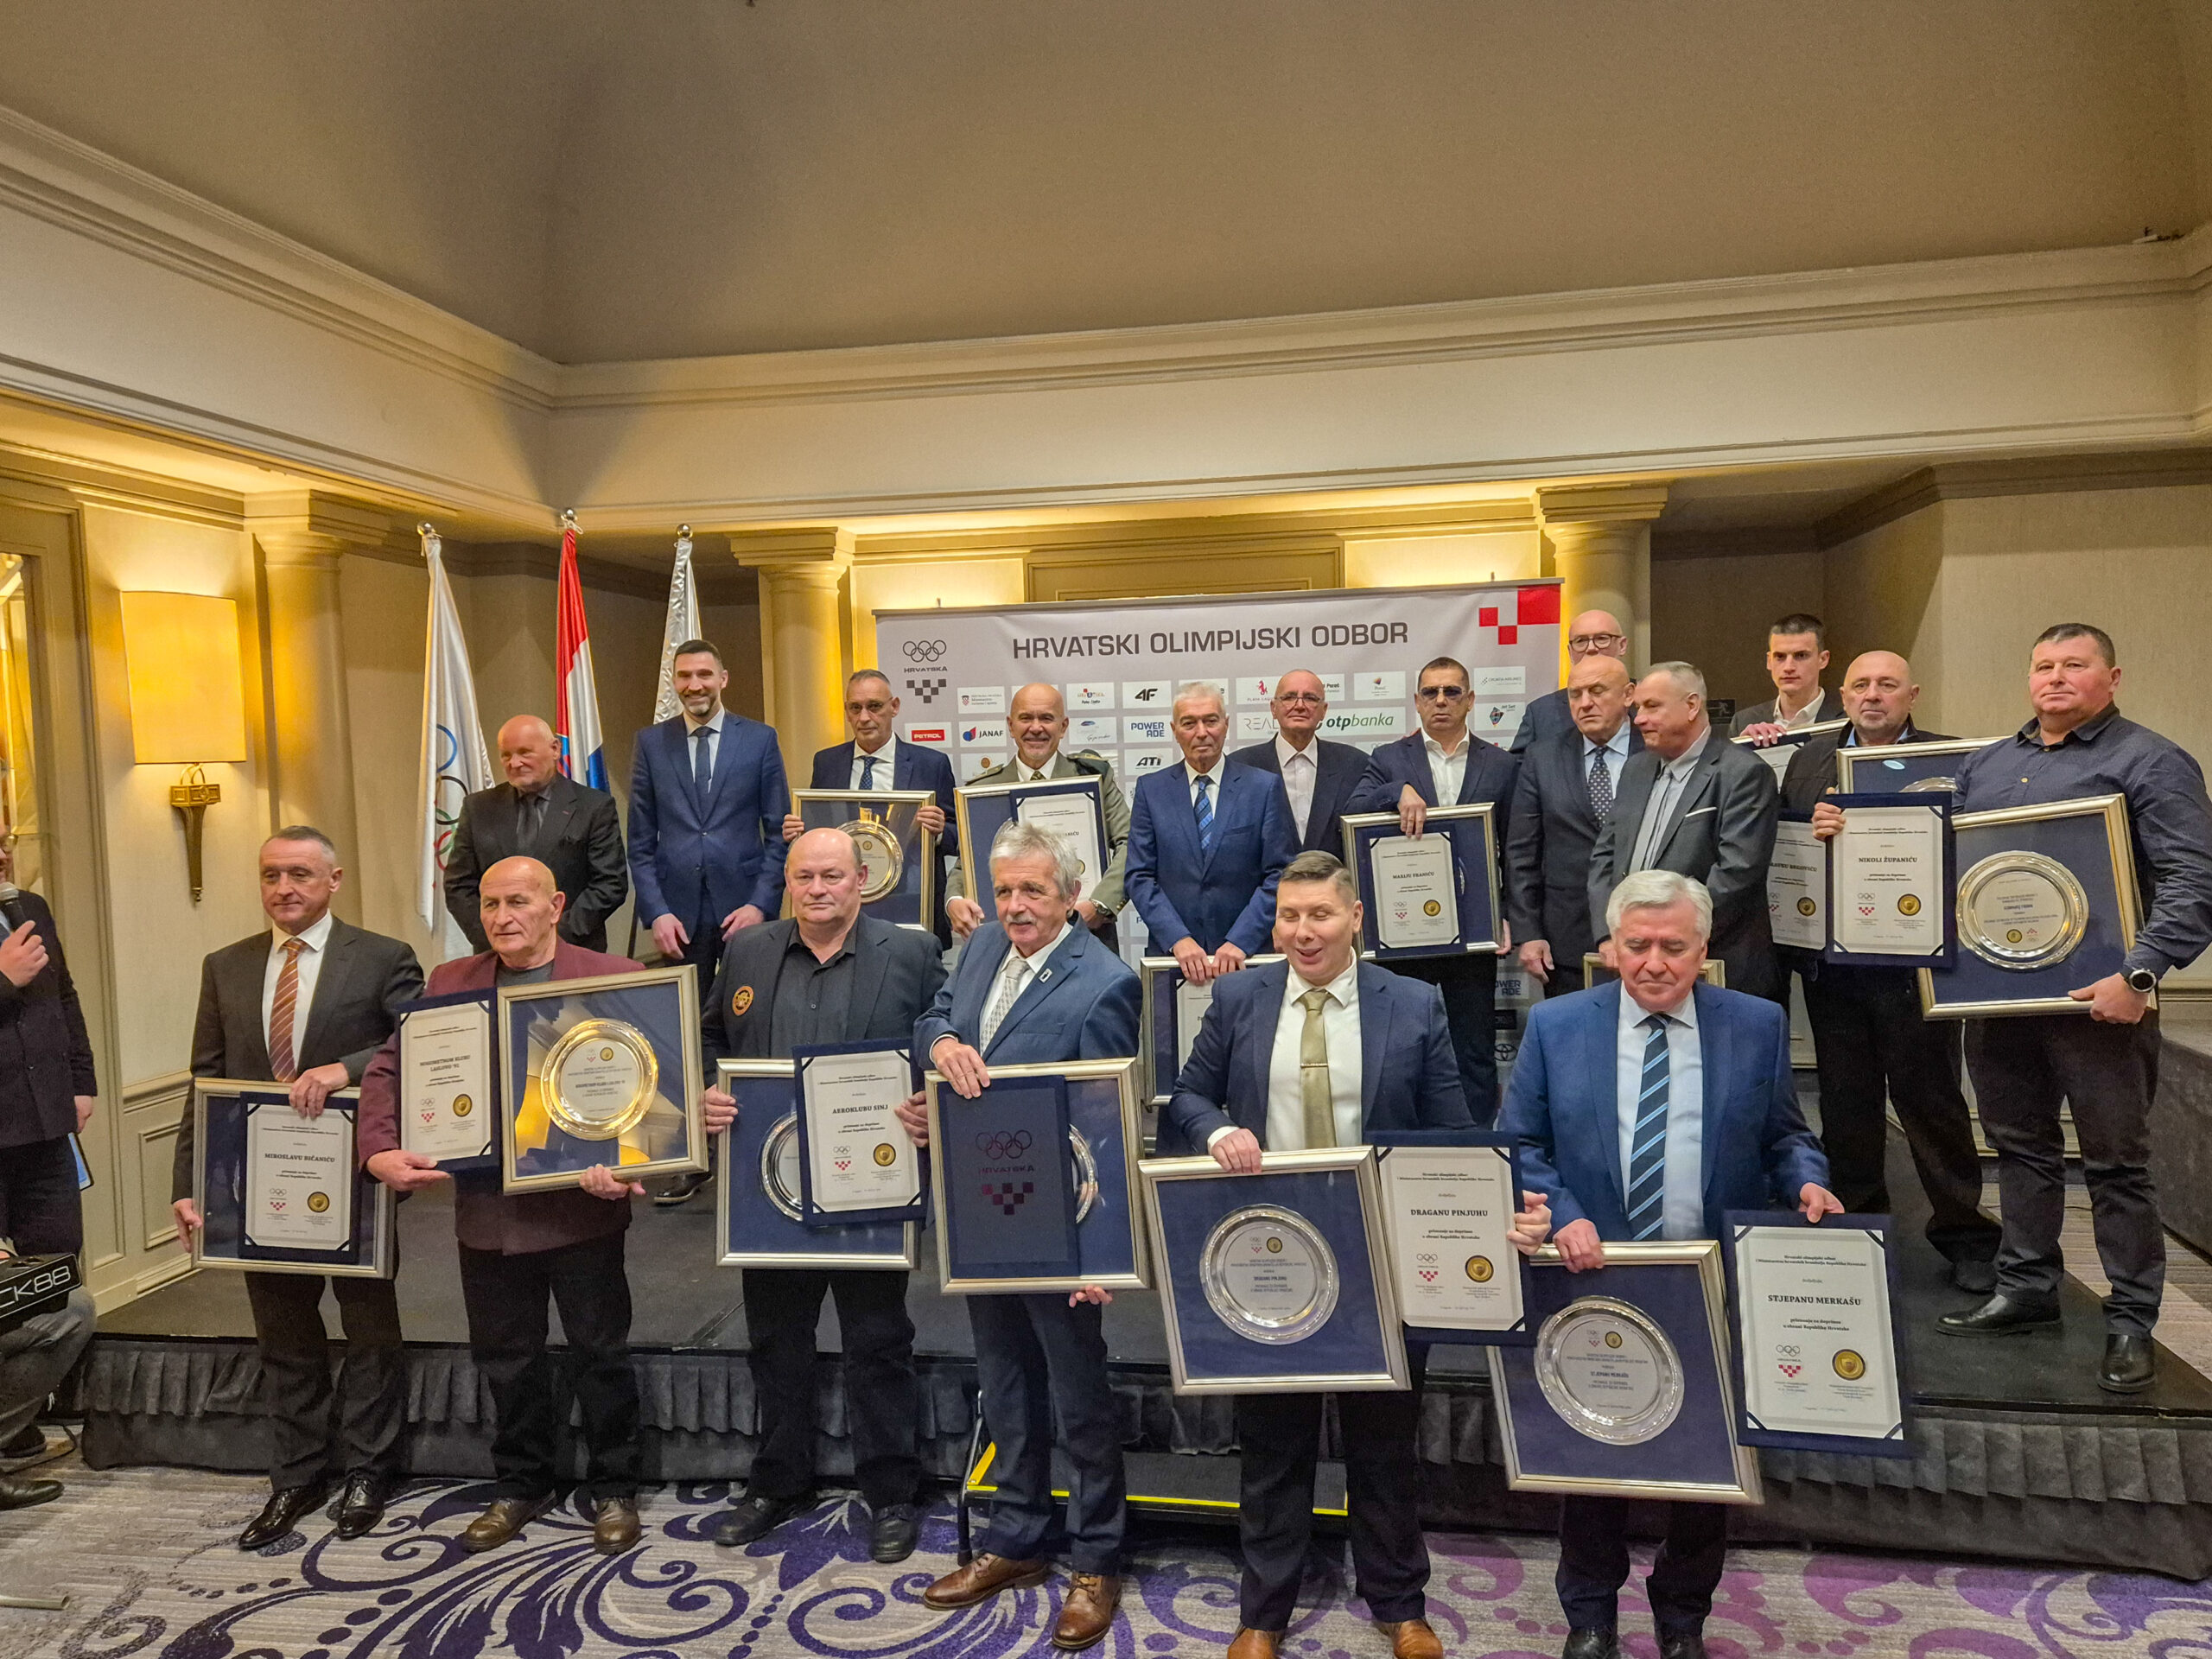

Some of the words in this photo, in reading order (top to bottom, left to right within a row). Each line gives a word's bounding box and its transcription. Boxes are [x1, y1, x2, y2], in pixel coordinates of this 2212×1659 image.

[1013, 633, 1140, 659] HRVATSKI
[1149, 626, 1300, 654] OLIMPIJSKI
[1311, 621, 1408, 647] ODBOR
[1135, 688, 1158, 702] 4F
[1130, 721, 1165, 730] POWER
[1326, 712, 1394, 731] otpbanka
[978, 729, 1004, 739] JANAF
[1146, 729, 1165, 738] ADE
[832, 1106, 872, 1115] AEROKLUBU
[264, 1153, 303, 1161] MIROSLAVU
[1410, 1208, 1450, 1217] DRAGANU
[1768, 1294, 1814, 1304] STJEPANU
[1816, 1295, 1861, 1306] MERKAŠU
